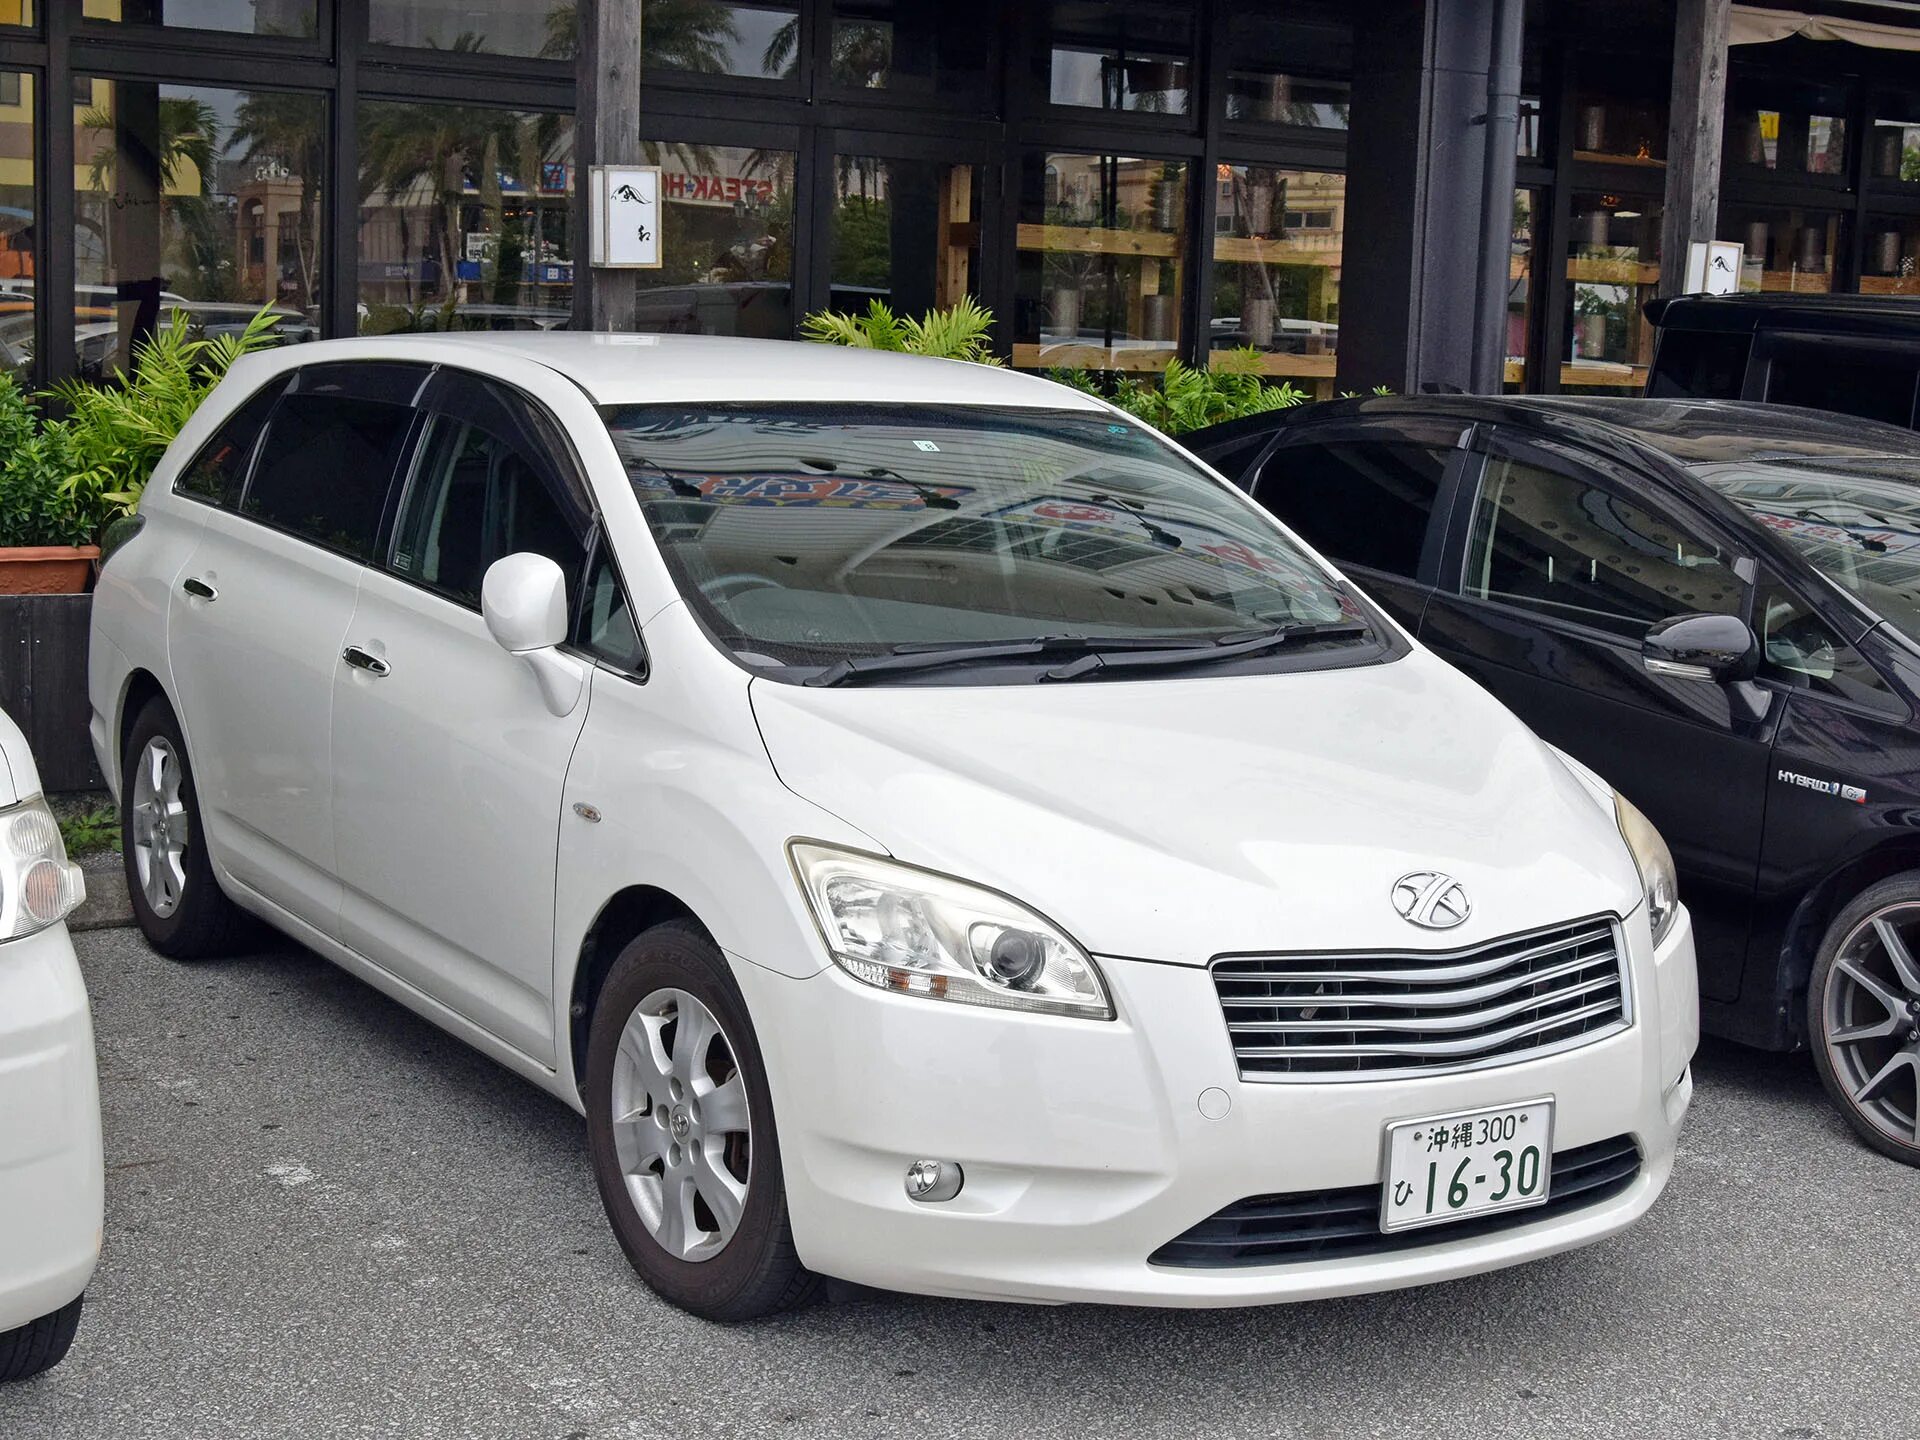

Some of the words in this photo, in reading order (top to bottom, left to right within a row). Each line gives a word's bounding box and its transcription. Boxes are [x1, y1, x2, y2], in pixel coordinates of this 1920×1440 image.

[1778, 770, 1829, 793] HYBRID
[1395, 1180, 1413, 1206] ひ
[1425, 1145, 1540, 1214] 16-30
